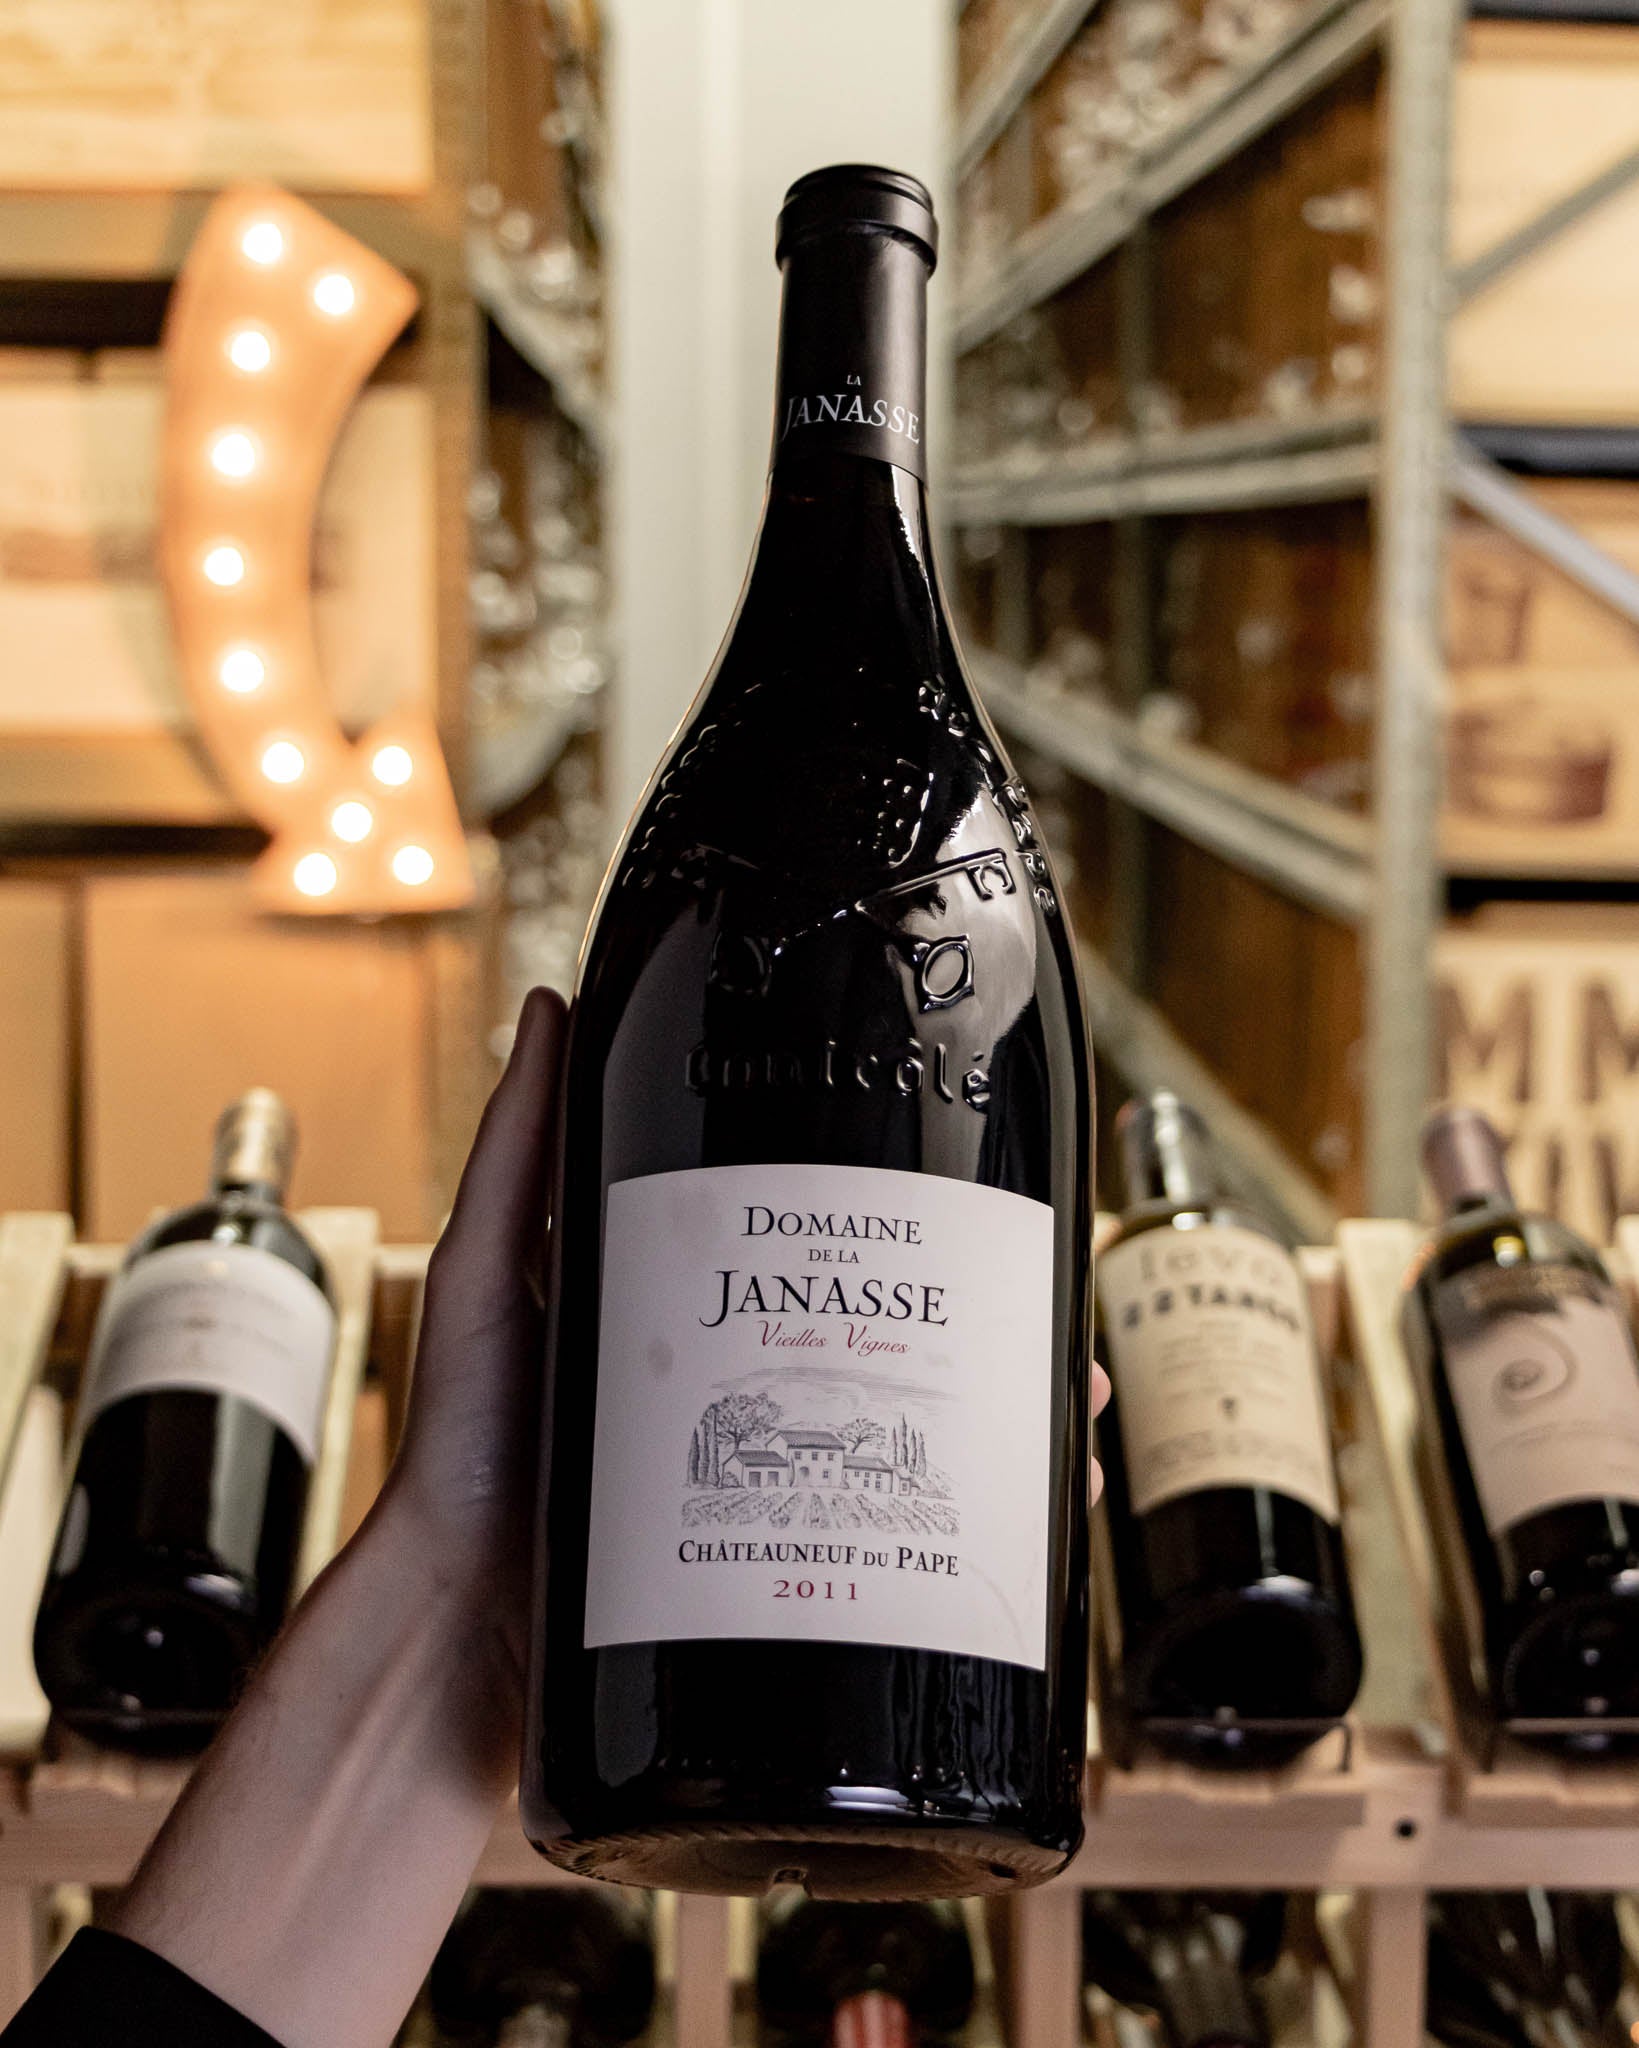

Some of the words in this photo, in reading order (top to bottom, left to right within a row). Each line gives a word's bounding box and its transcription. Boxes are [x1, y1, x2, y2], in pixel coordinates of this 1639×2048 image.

[846, 374, 862, 387] LA
[780, 394, 920, 444] JANASSE
[741, 1206, 923, 1246] DOMAINE
[808, 1249, 833, 1262] DE
[837, 1250, 860, 1264] LA
[699, 1269, 949, 1328] JANASSE
[758, 1319, 828, 1349] Vieilles
[843, 1321, 911, 1357] Vignes
[678, 1539, 857, 1565] CHÂTEAUNEUF
[862, 1550, 889, 1568] DU
[895, 1546, 960, 1577] PAPE
[772, 1579, 858, 1601] 2011
